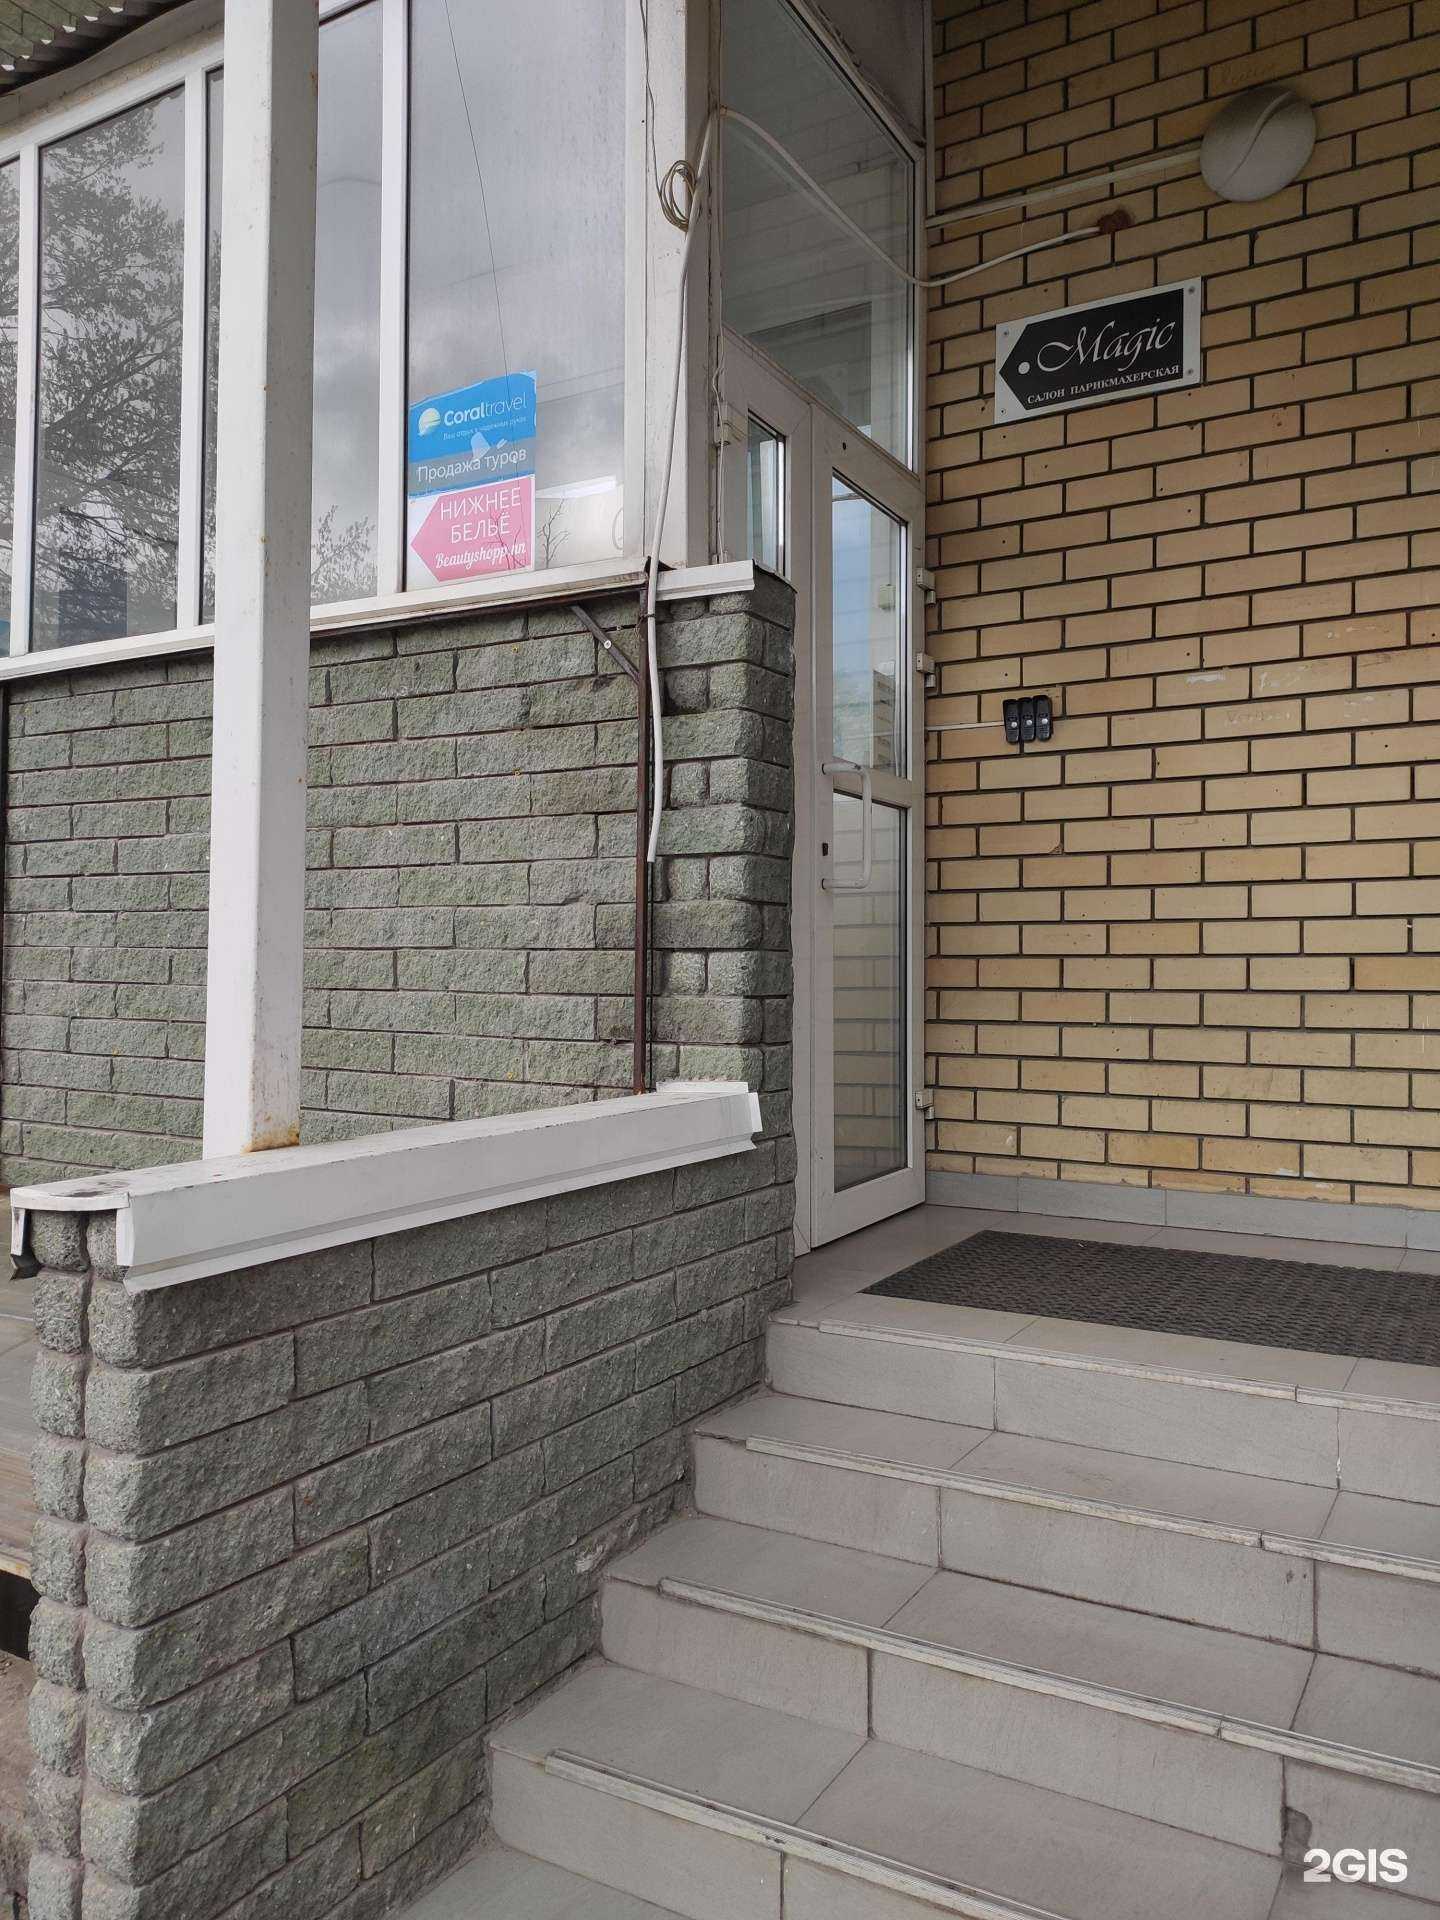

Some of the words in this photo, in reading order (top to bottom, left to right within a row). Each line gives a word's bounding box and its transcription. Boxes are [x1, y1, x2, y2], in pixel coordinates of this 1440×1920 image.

[1037, 318, 1176, 372] Magic
[1027, 388, 1065, 404] САЛОН
[1070, 364, 1179, 395] ПАРИКМАХЕРСКАЯ
[417, 458, 481, 482] Продажа
[484, 449, 527, 471] туров
[440, 487, 520, 520] НИЖНЕЕ
[451, 511, 510, 544] БЕЛЬЁ
